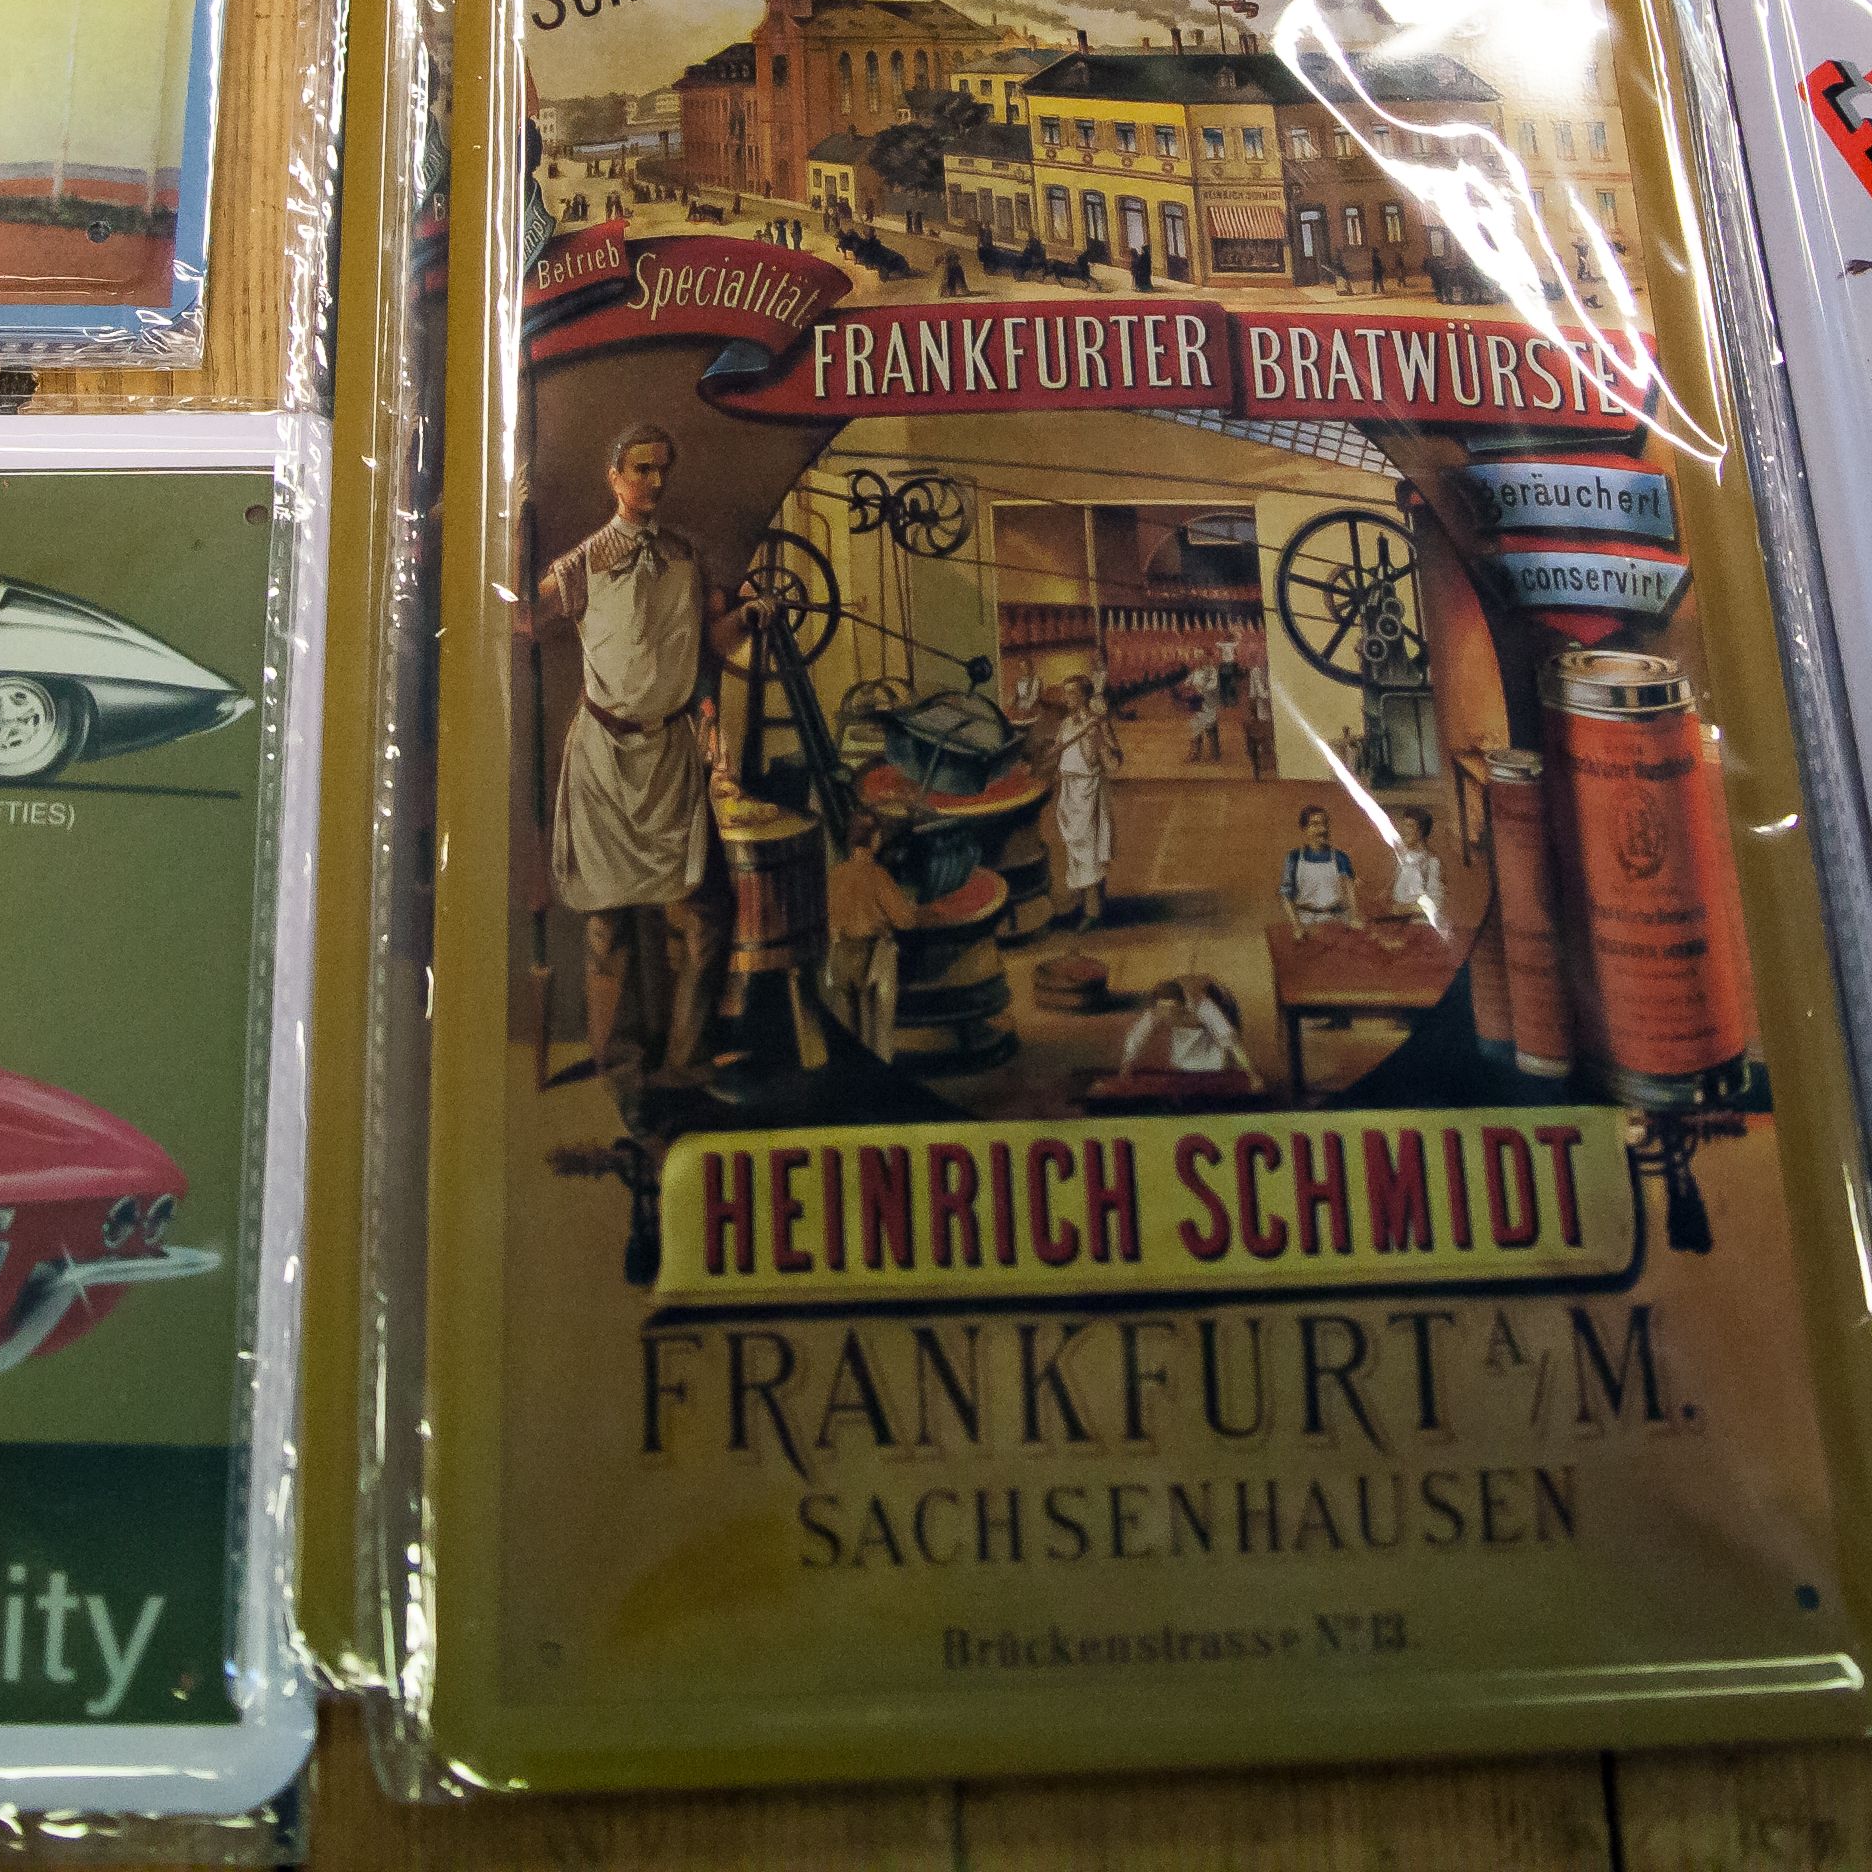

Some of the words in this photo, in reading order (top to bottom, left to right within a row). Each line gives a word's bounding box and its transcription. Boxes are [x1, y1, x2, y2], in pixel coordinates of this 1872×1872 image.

[536, 238, 621, 291] Betrieb
[811, 313, 1215, 401] FRANKFURTER
[1250, 310, 1626, 416] BRATWÜRSTE
[703, 1135, 1144, 1276] HEINRICH
[1172, 1125, 1588, 1263] SCHMIDT
[637, 1310, 1464, 1481] FRANKFURT
[796, 1463, 1583, 1572] SACHSENHAUSEN
